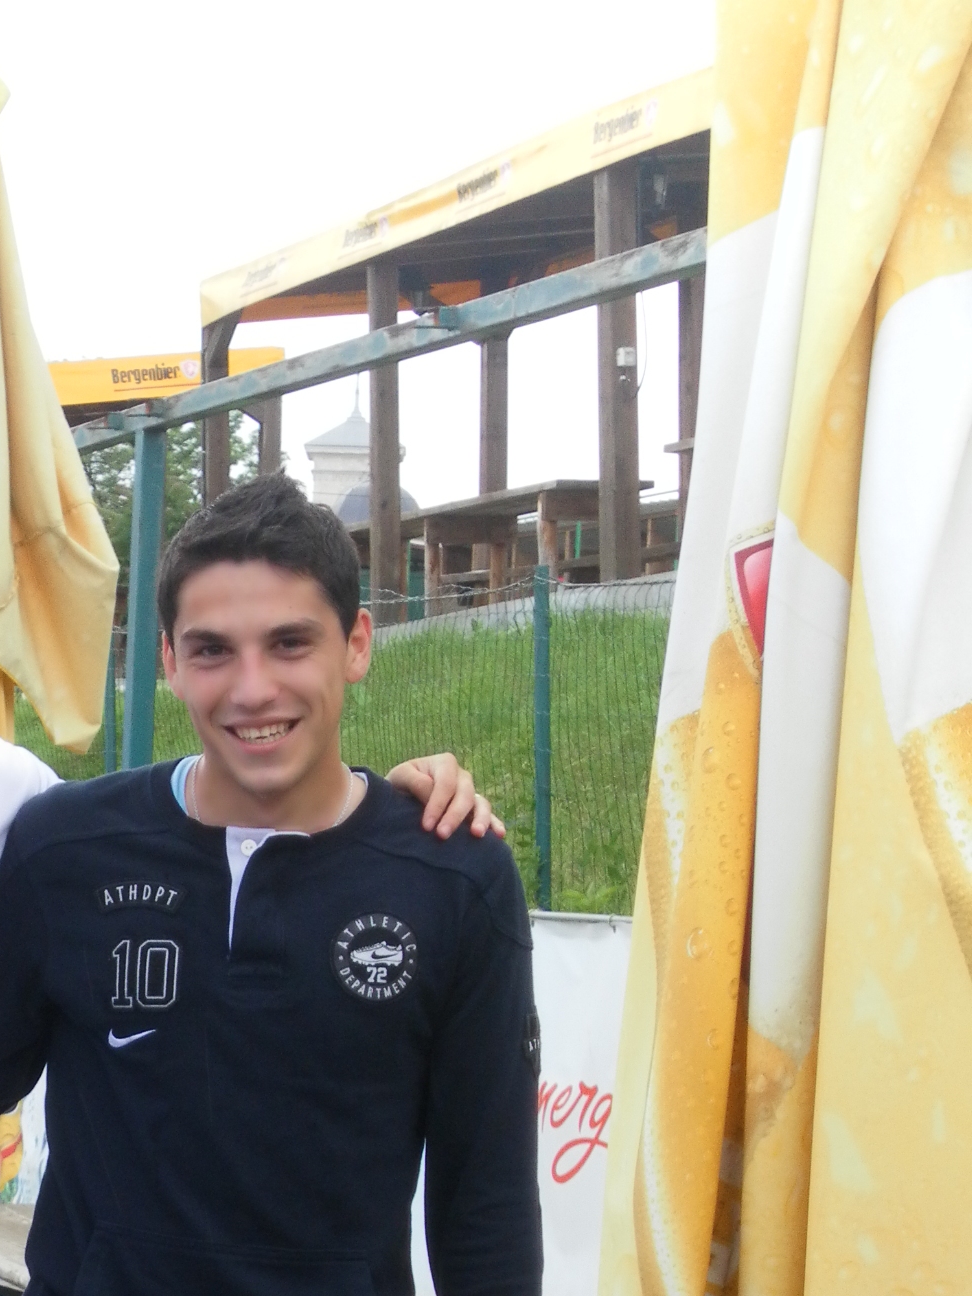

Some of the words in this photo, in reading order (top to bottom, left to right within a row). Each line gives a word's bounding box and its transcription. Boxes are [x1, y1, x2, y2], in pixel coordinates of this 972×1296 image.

[111, 363, 180, 384] Bergenbier
[104, 884, 178, 906] ATHDPT
[337, 915, 417, 952] ATHLETIC
[111, 939, 180, 1008] 10
[339, 966, 413, 1000] DEPARTMENT
[366, 966, 388, 984] 72
